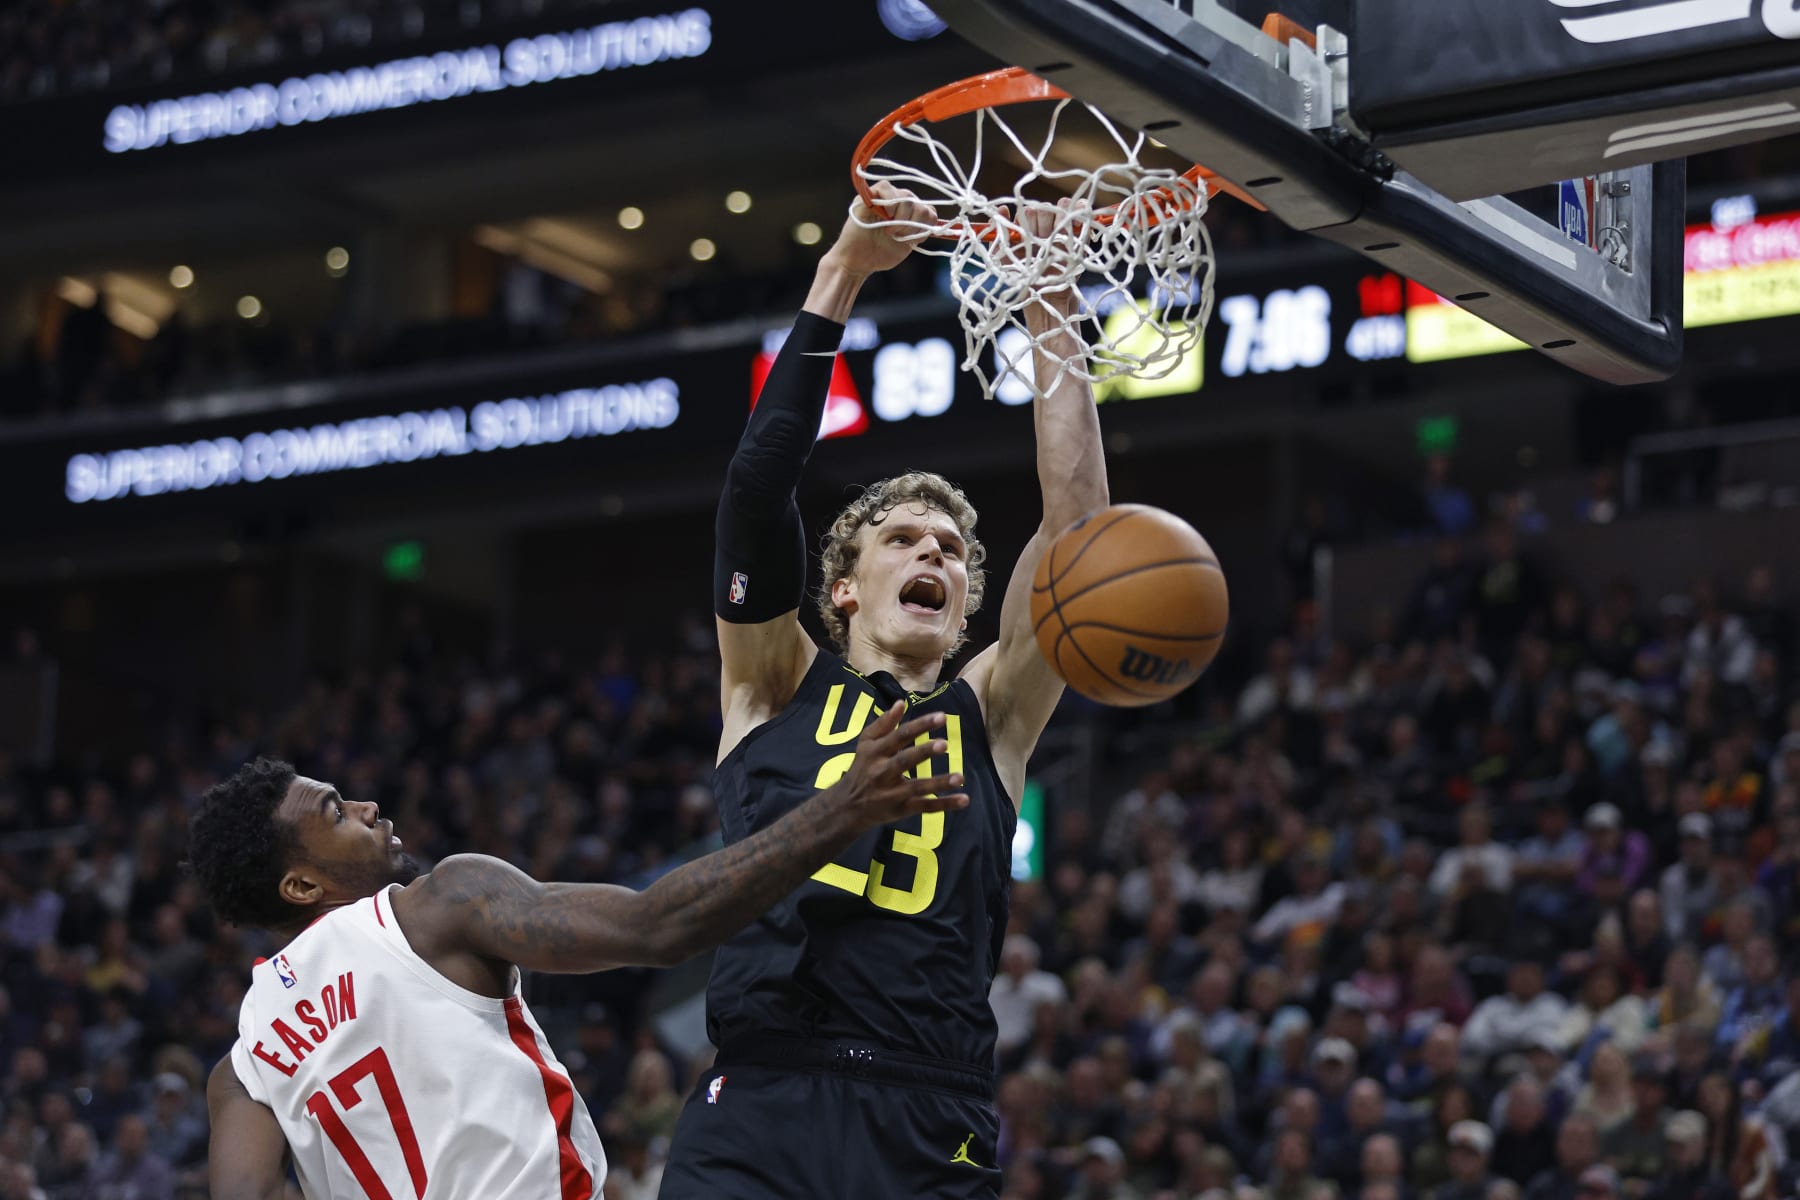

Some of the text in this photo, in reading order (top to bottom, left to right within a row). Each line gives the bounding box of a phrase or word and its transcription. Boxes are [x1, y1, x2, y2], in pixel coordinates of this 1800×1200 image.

[504, 8, 711, 86] SOLUTIONS
[1564, 201, 1582, 237] NBA
[471, 377, 679, 451] SOLUTIONS
[815, 683, 964, 787] UH
[252, 971, 357, 1077] EASON
[306, 1046, 428, 1200] 17
